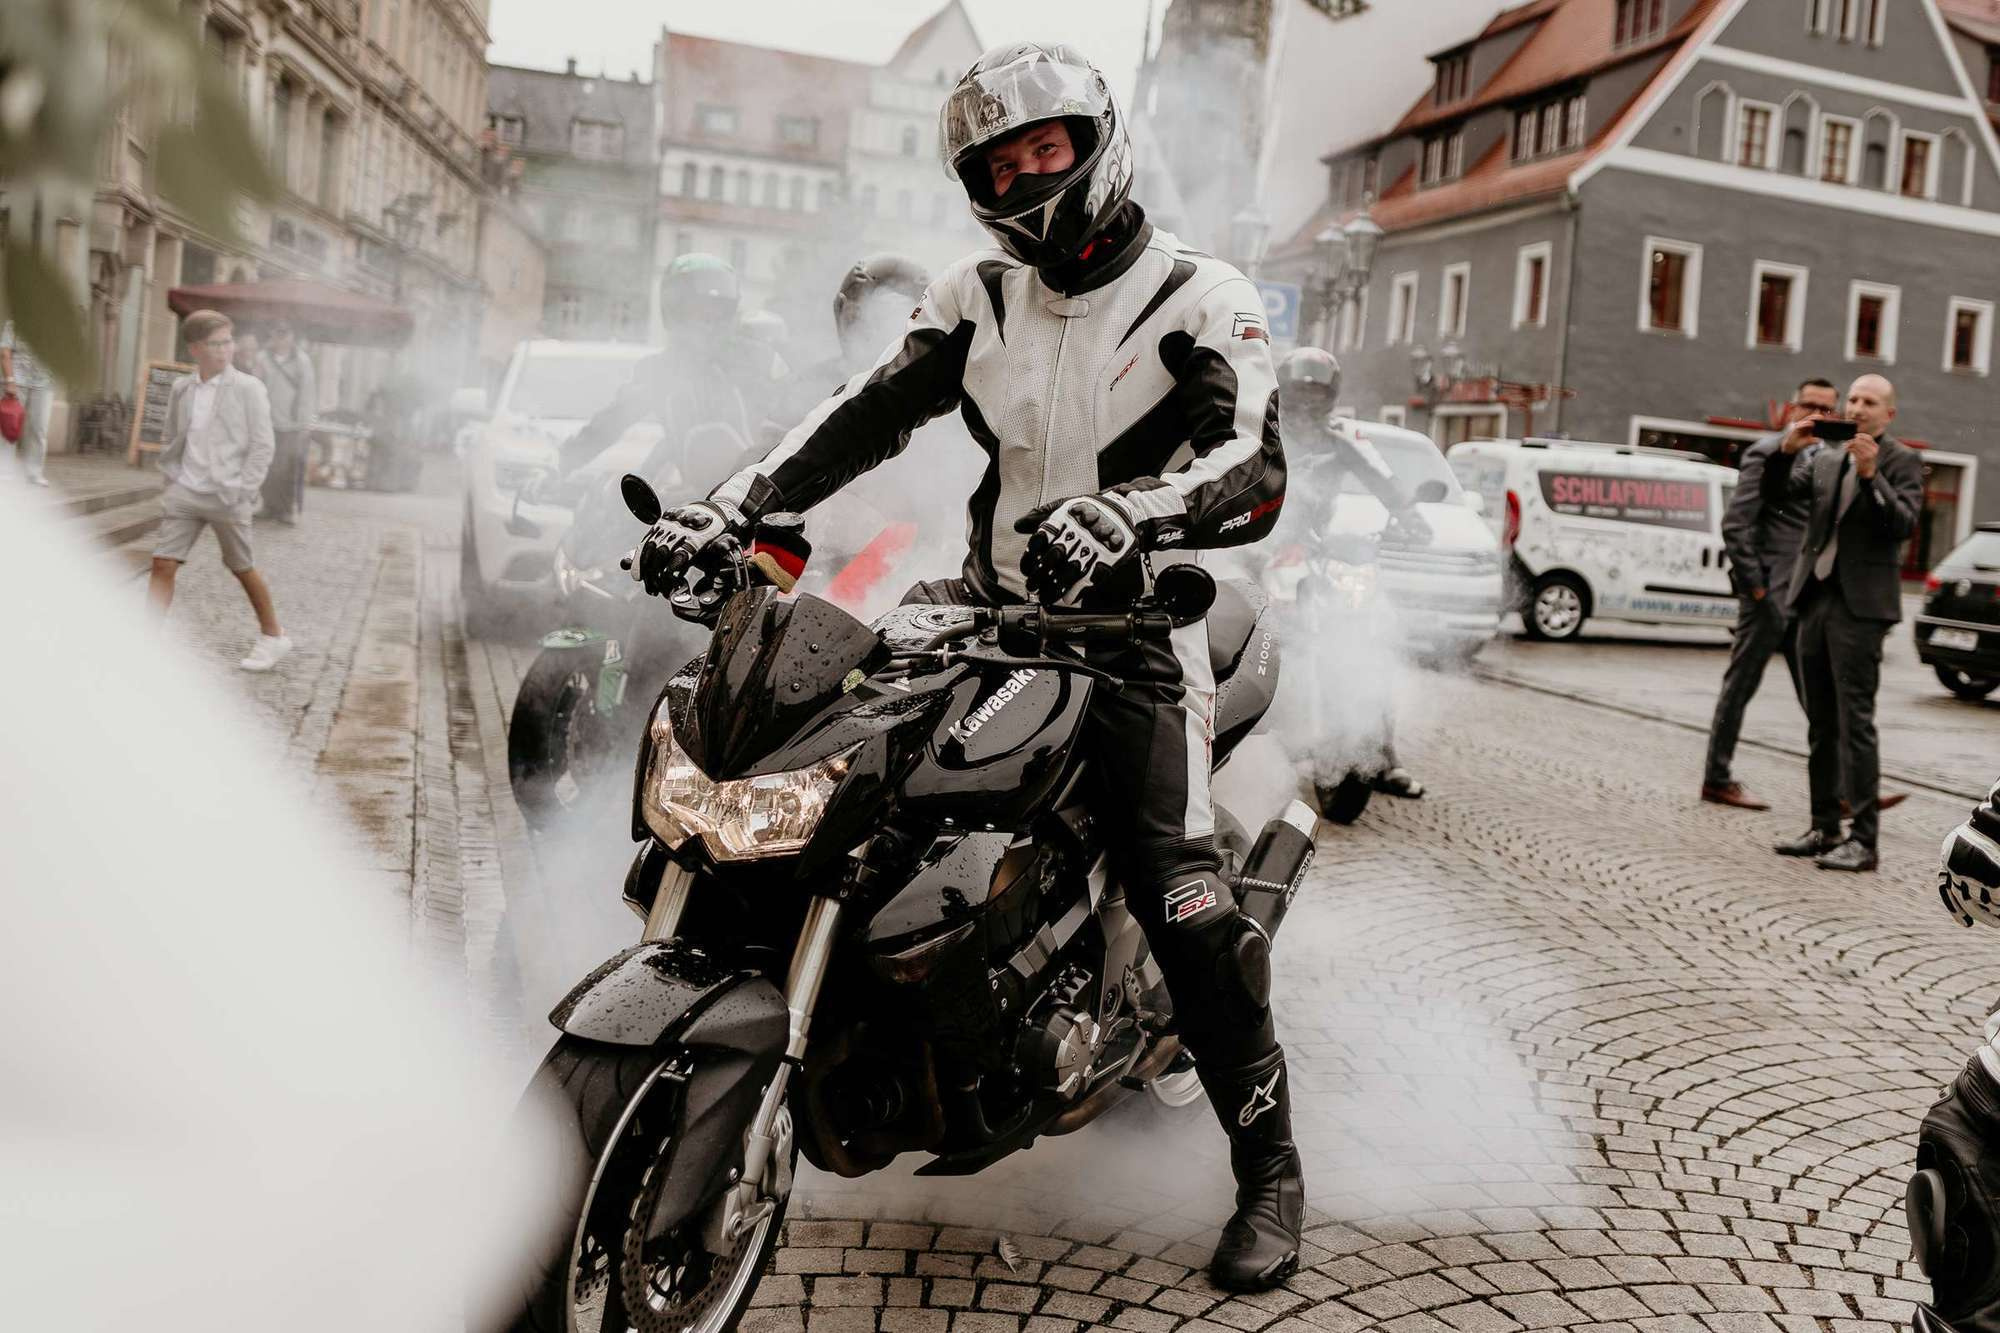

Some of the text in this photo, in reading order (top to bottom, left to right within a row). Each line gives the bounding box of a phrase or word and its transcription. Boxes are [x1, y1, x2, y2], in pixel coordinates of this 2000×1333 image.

[977, 113, 1018, 136] SHARK
[1552, 475, 1707, 511] SCHLAFWAGEN
[1257, 632, 1271, 676] Z1000
